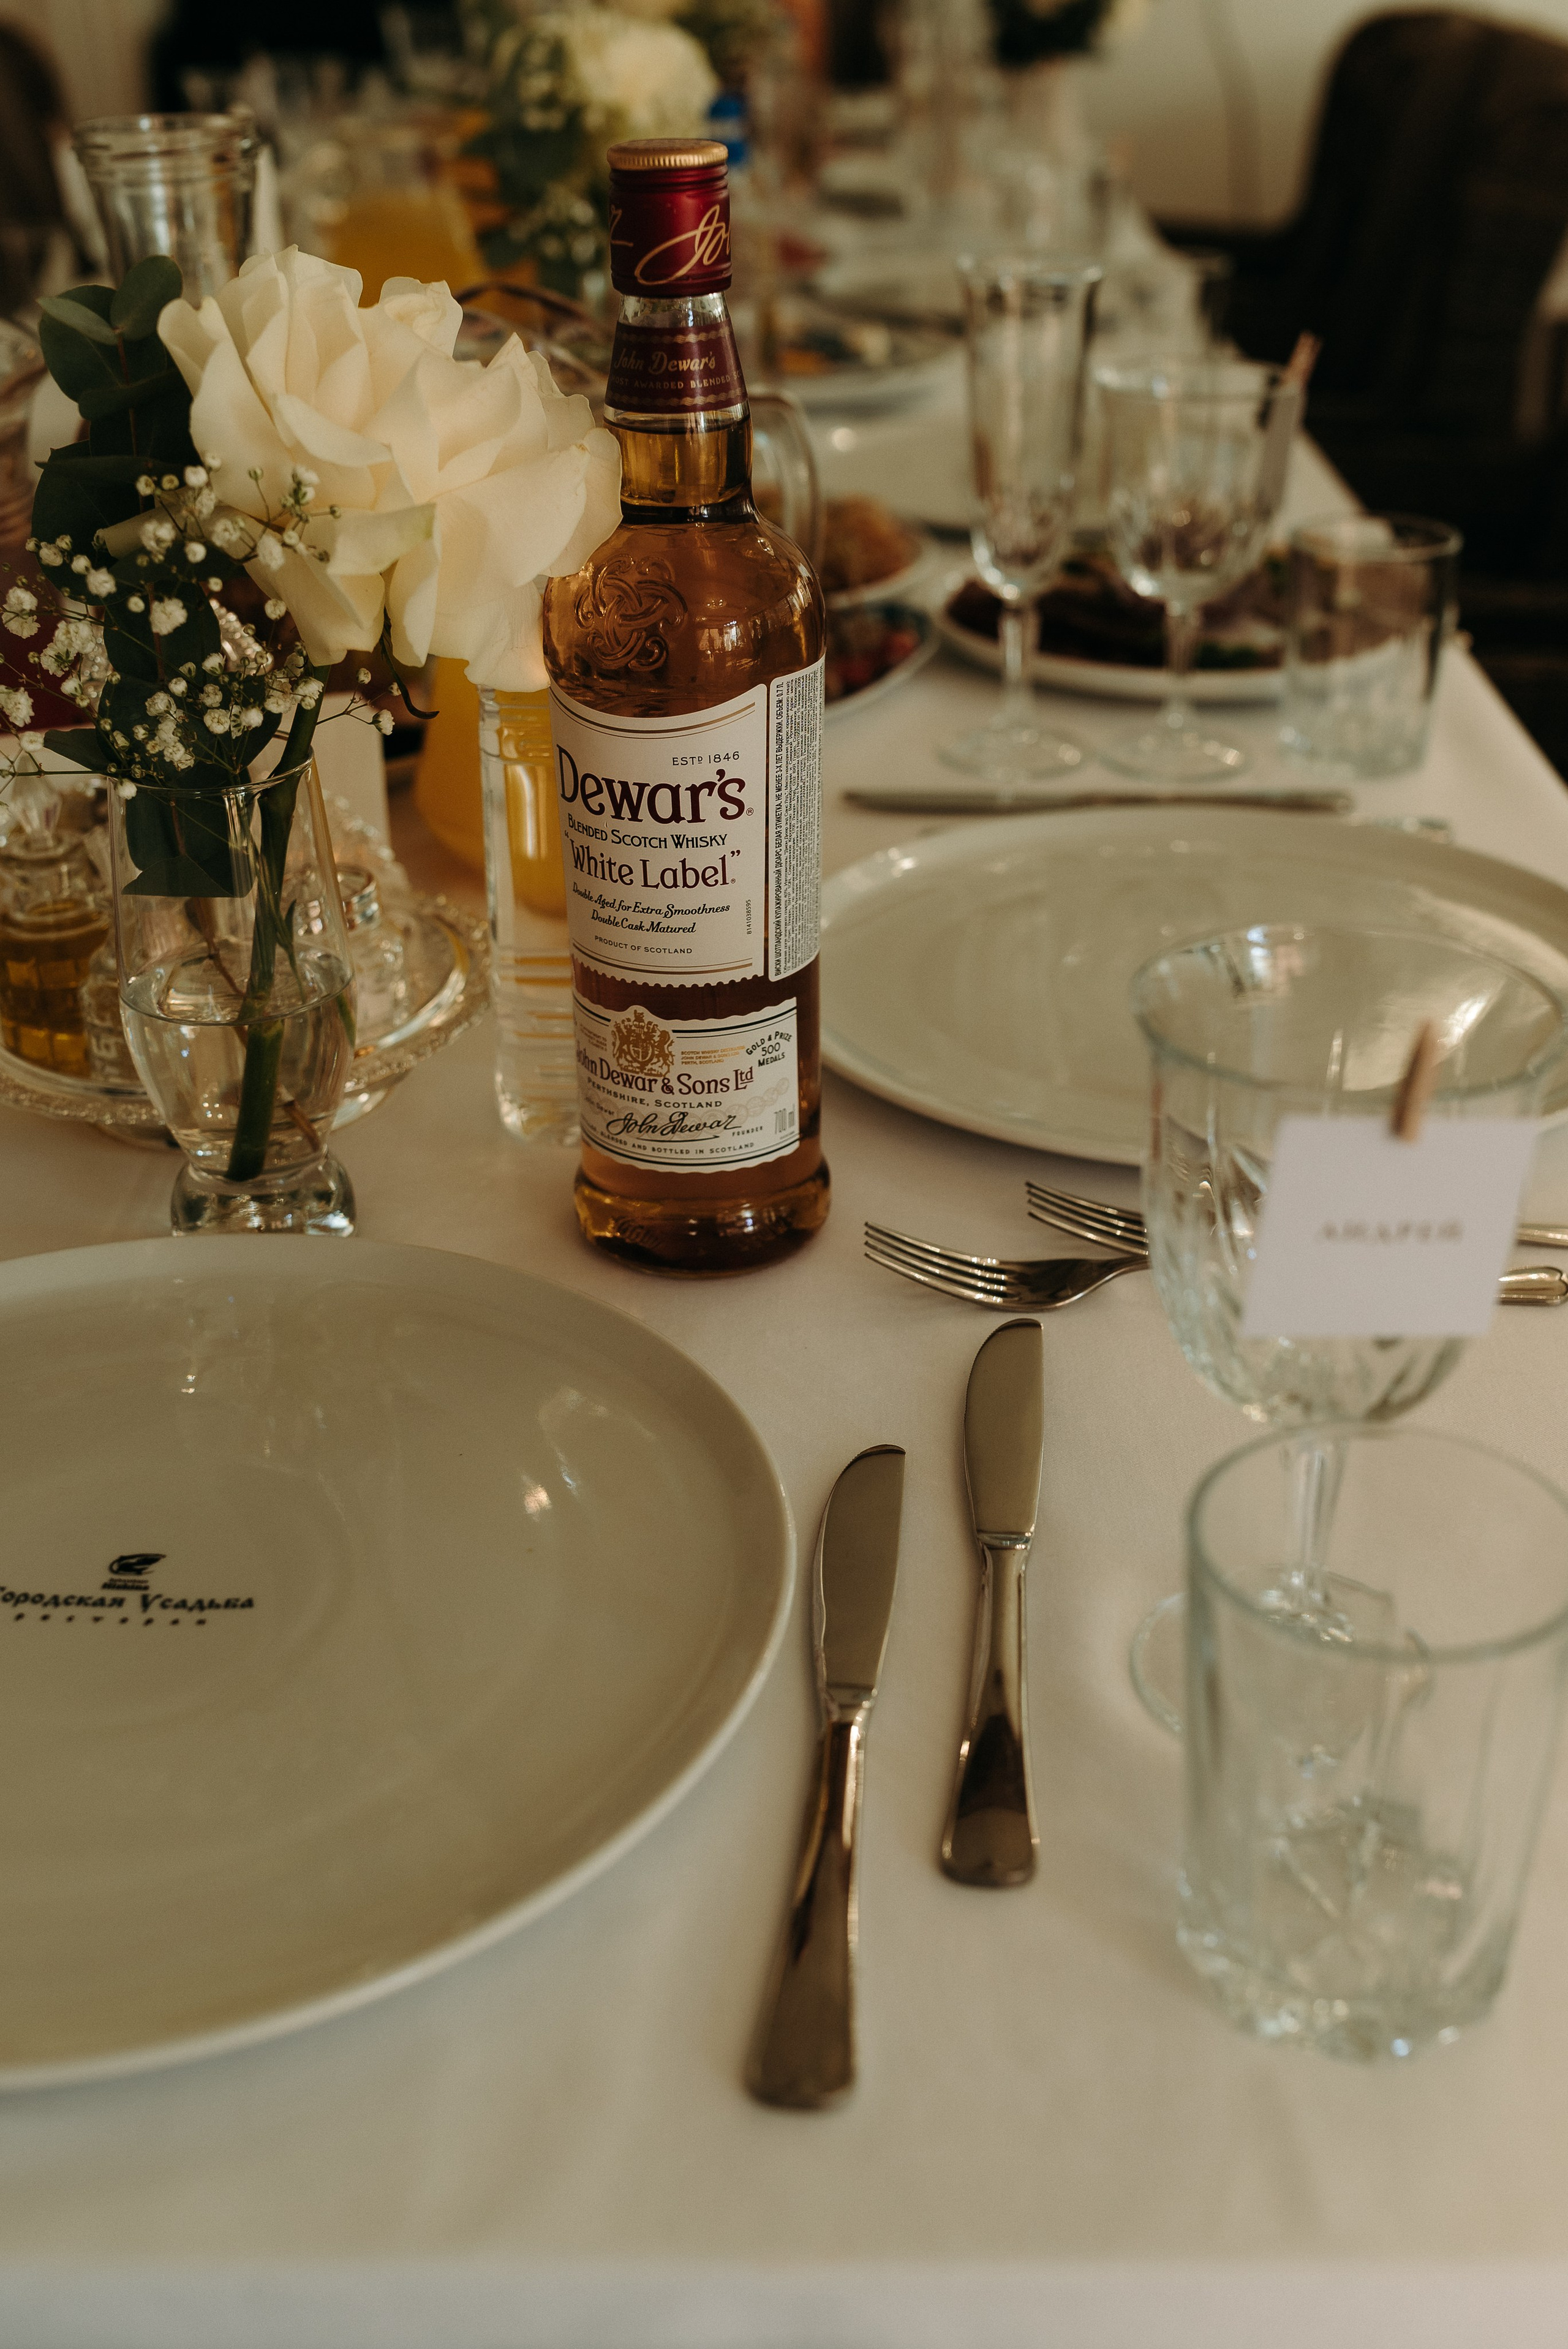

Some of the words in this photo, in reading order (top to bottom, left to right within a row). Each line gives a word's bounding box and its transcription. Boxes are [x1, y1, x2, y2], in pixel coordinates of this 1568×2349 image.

[647, 351, 716, 375] Dewar's
[634, 379, 684, 390] AWARDED
[690, 374, 731, 388] BLENDED
[707, 751, 740, 764] 1846
[556, 744, 746, 824] Dewar's
[775, 793, 782, 801] НЕ
[567, 813, 608, 842] BLENDED
[611, 829, 668, 849] SCOTCH
[670, 834, 728, 849] WHISKY
[572, 881, 594, 902] Double
[594, 894, 616, 909] Aged
[615, 900, 632, 912] for
[631, 901, 664, 915] Extra
[662, 903, 731, 919] Smoothness
[773, 869, 782, 919] КУПАЖИРОВАННЫЙ
[590, 908, 620, 928] Double
[620, 918, 646, 932] Cask
[645, 921, 697, 934] Matured
[594, 935, 628, 949] PRODUCT
[773, 919, 783, 959] ШОТЛАНДСКИЙ
[745, 1038, 766, 1055] GOLD
[774, 1031, 793, 1043] PRIZE
[761, 1042, 781, 1057] 500
[758, 1052, 785, 1068] MEDALS
[598, 1056, 658, 1093] Dewar
[661, 1077, 675, 1096] &
[676, 1073, 731, 1095] Sons
[733, 1066, 754, 1092] Ltd
[654, 1099, 723, 1109] SCOTLAND
[651, 1146, 690, 1155] BOTTLED
[709, 1142, 755, 1153] SCOTLAND
